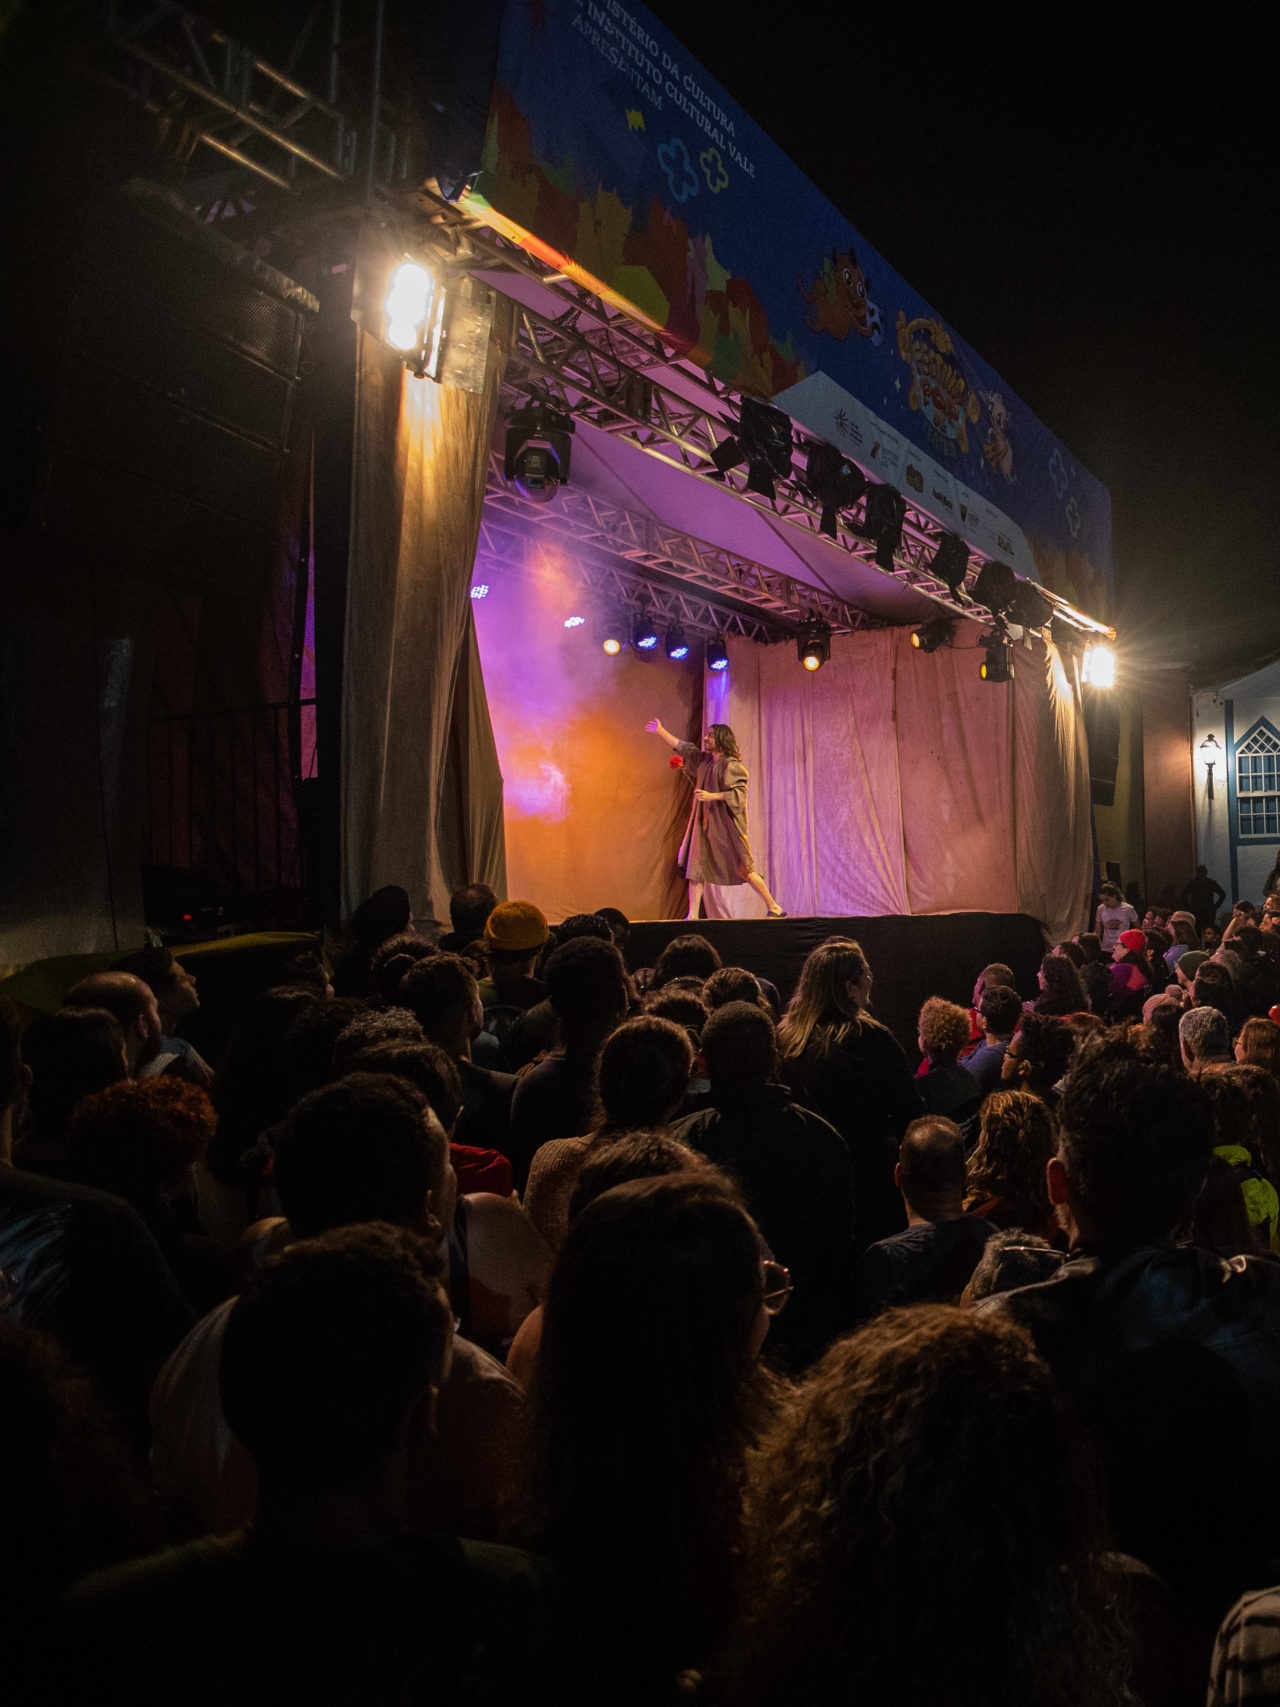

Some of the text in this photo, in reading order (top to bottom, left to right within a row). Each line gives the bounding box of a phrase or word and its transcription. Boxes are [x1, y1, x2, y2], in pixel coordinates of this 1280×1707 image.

[605, 0, 736, 137] ISTÉRIO DA CULTURA
[665, 81, 726, 150] CULTURAL
[727, 141, 756, 179] VALE
